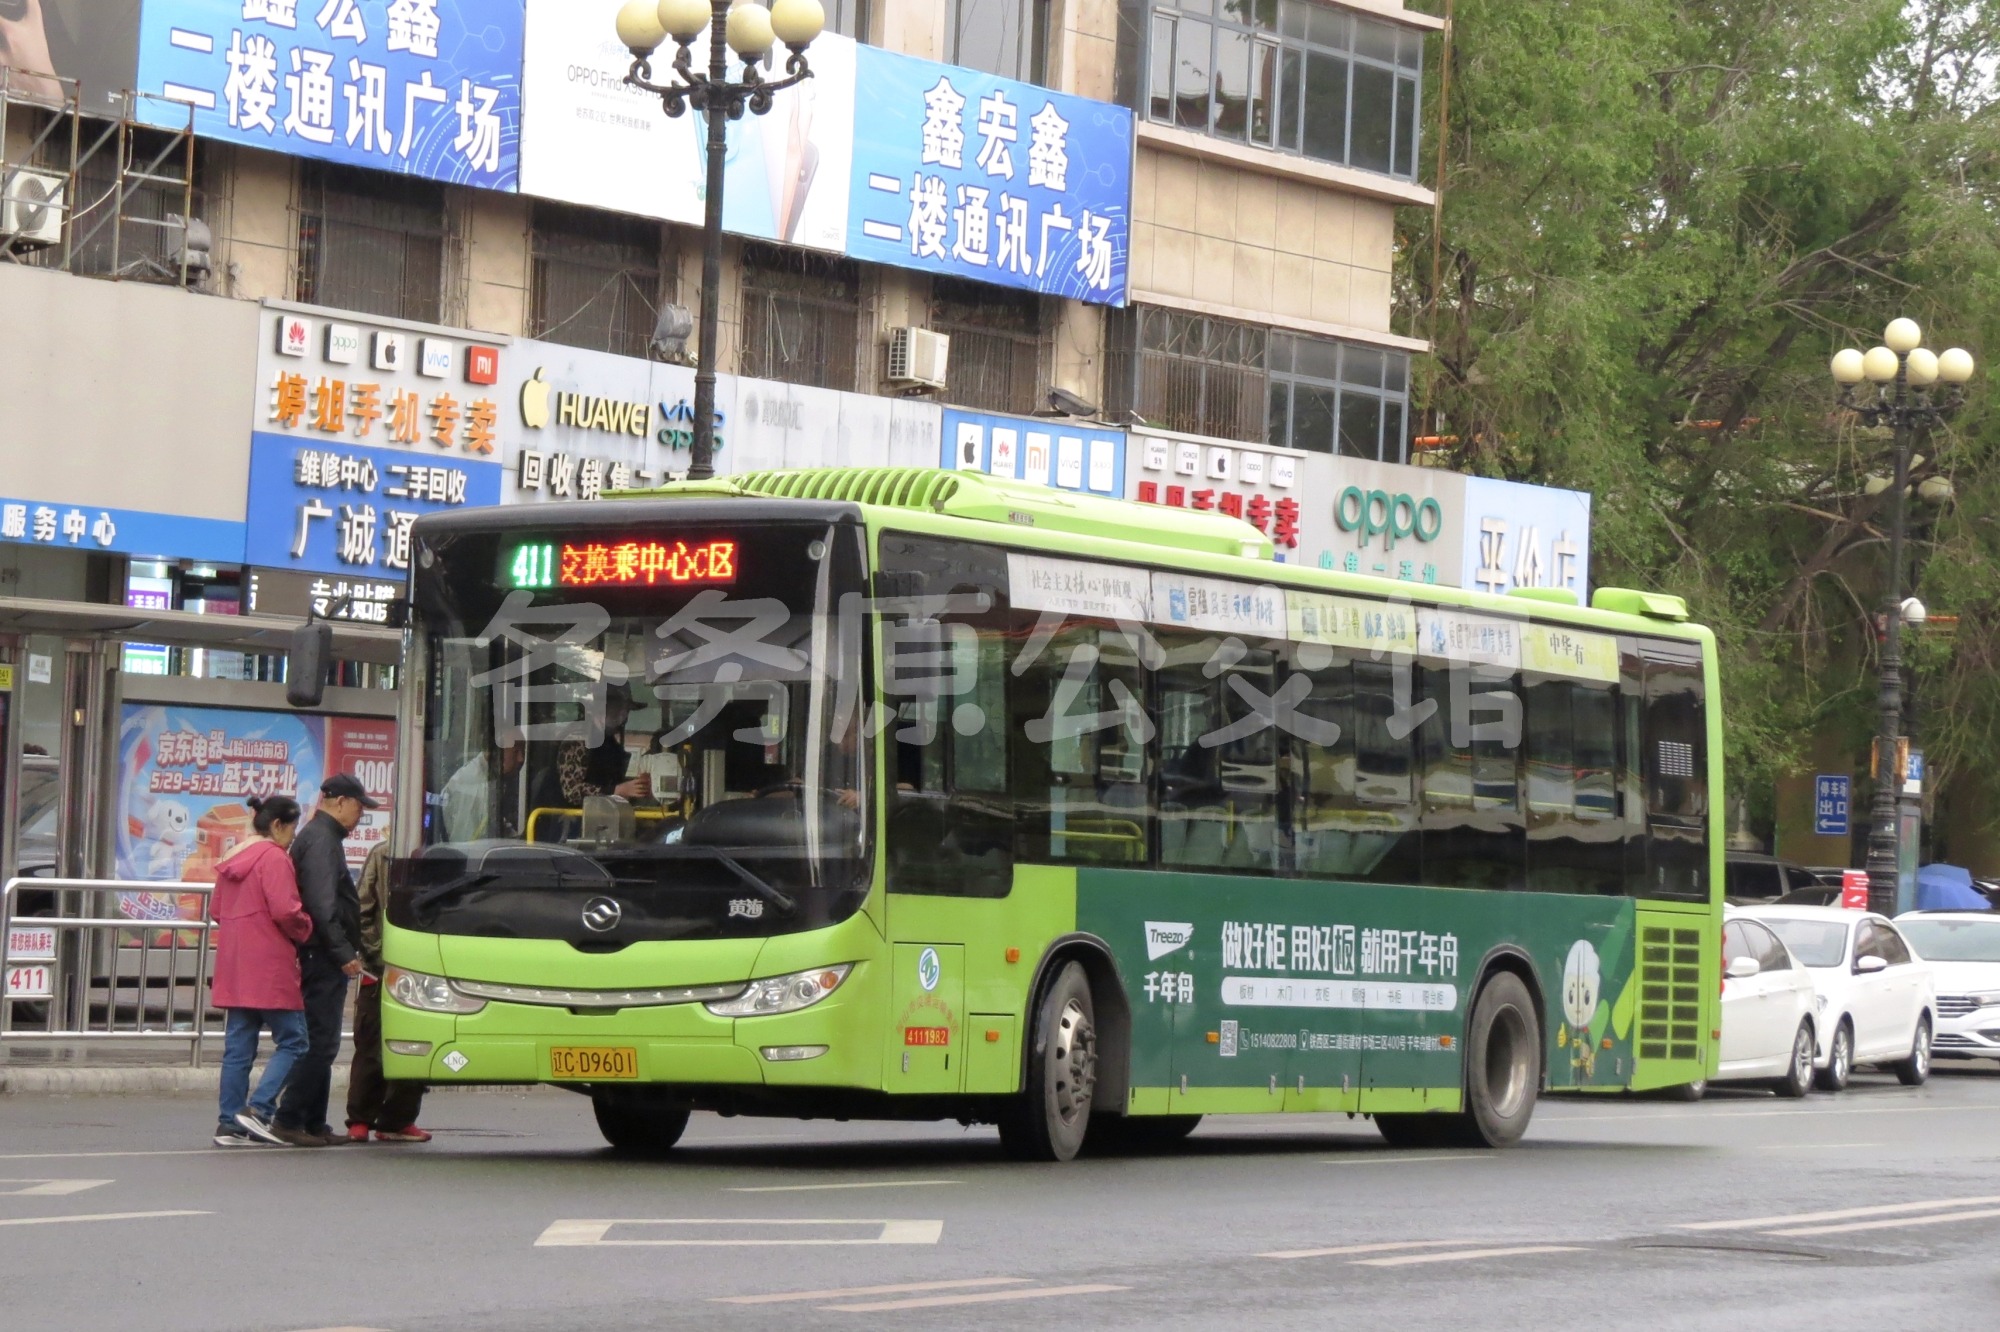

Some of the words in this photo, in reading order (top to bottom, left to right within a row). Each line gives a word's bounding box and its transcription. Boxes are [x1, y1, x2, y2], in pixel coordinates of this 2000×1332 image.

[240, 0, 441, 58] 宏鑫
[567, 64, 598, 86] OPPO
[600, 71, 622, 91] Find
[163, 29, 500, 172] 二楼通讯广场
[921, 76, 1070, 191] 鑫宏鑫
[862, 171, 1112, 290] 二楼通讯广场
[332, 335, 357, 349] oppo
[427, 348, 450, 368] vivo
[270, 370, 497, 454] 婷姐手机专卖
[557, 392, 652, 438] HUAWEI
[657, 427, 724, 451] opo
[1060, 457, 1079, 469] vivo
[1246, 463, 1261, 471] oppo
[1277, 469, 1292, 478] vivo
[299, 450, 378, 492] 维修中心
[385, 465, 467, 503] 二手回收
[1, 504, 116, 546] 服务中心
[1335, 486, 1442, 550] oppo
[290, 499, 418, 568] 广诚通
[512, 545, 552, 585] 411
[562, 542, 734, 583] 交换乘中心C区
[1476, 516, 1579, 594] 平价店
[1032, 570, 1131, 599] 社会主义核心价值观
[128, 594, 165, 610] 手手机
[1820, 781, 1846, 797] 停车场
[1819, 800, 1846, 816] 出口
[728, 899, 763, 918] 黄海
[11, 932, 52, 952] 请您排队乘车
[1151, 929, 1184, 944] Treezo
[1221, 921, 1286, 970] 做好柜
[1291, 923, 1355, 975] 用好板
[1361, 927, 1458, 977] 就用千年舟
[10, 969, 44, 989] 411
[1144, 971, 1194, 1004] 千年舟
[1239, 984, 1254, 999] 板材
[1277, 985, 1292, 1000] 木门
[1315, 986, 1330, 1002] 衣柜
[908, 1030, 946, 1044] 4111982
[1250, 1033, 1297, 1048] 15140822808
[1407, 1035, 1457, 1052] 千年舟建材店
[445, 1055, 466, 1068] LNG
[553, 1051, 632, 1073] 辽C·D9601
